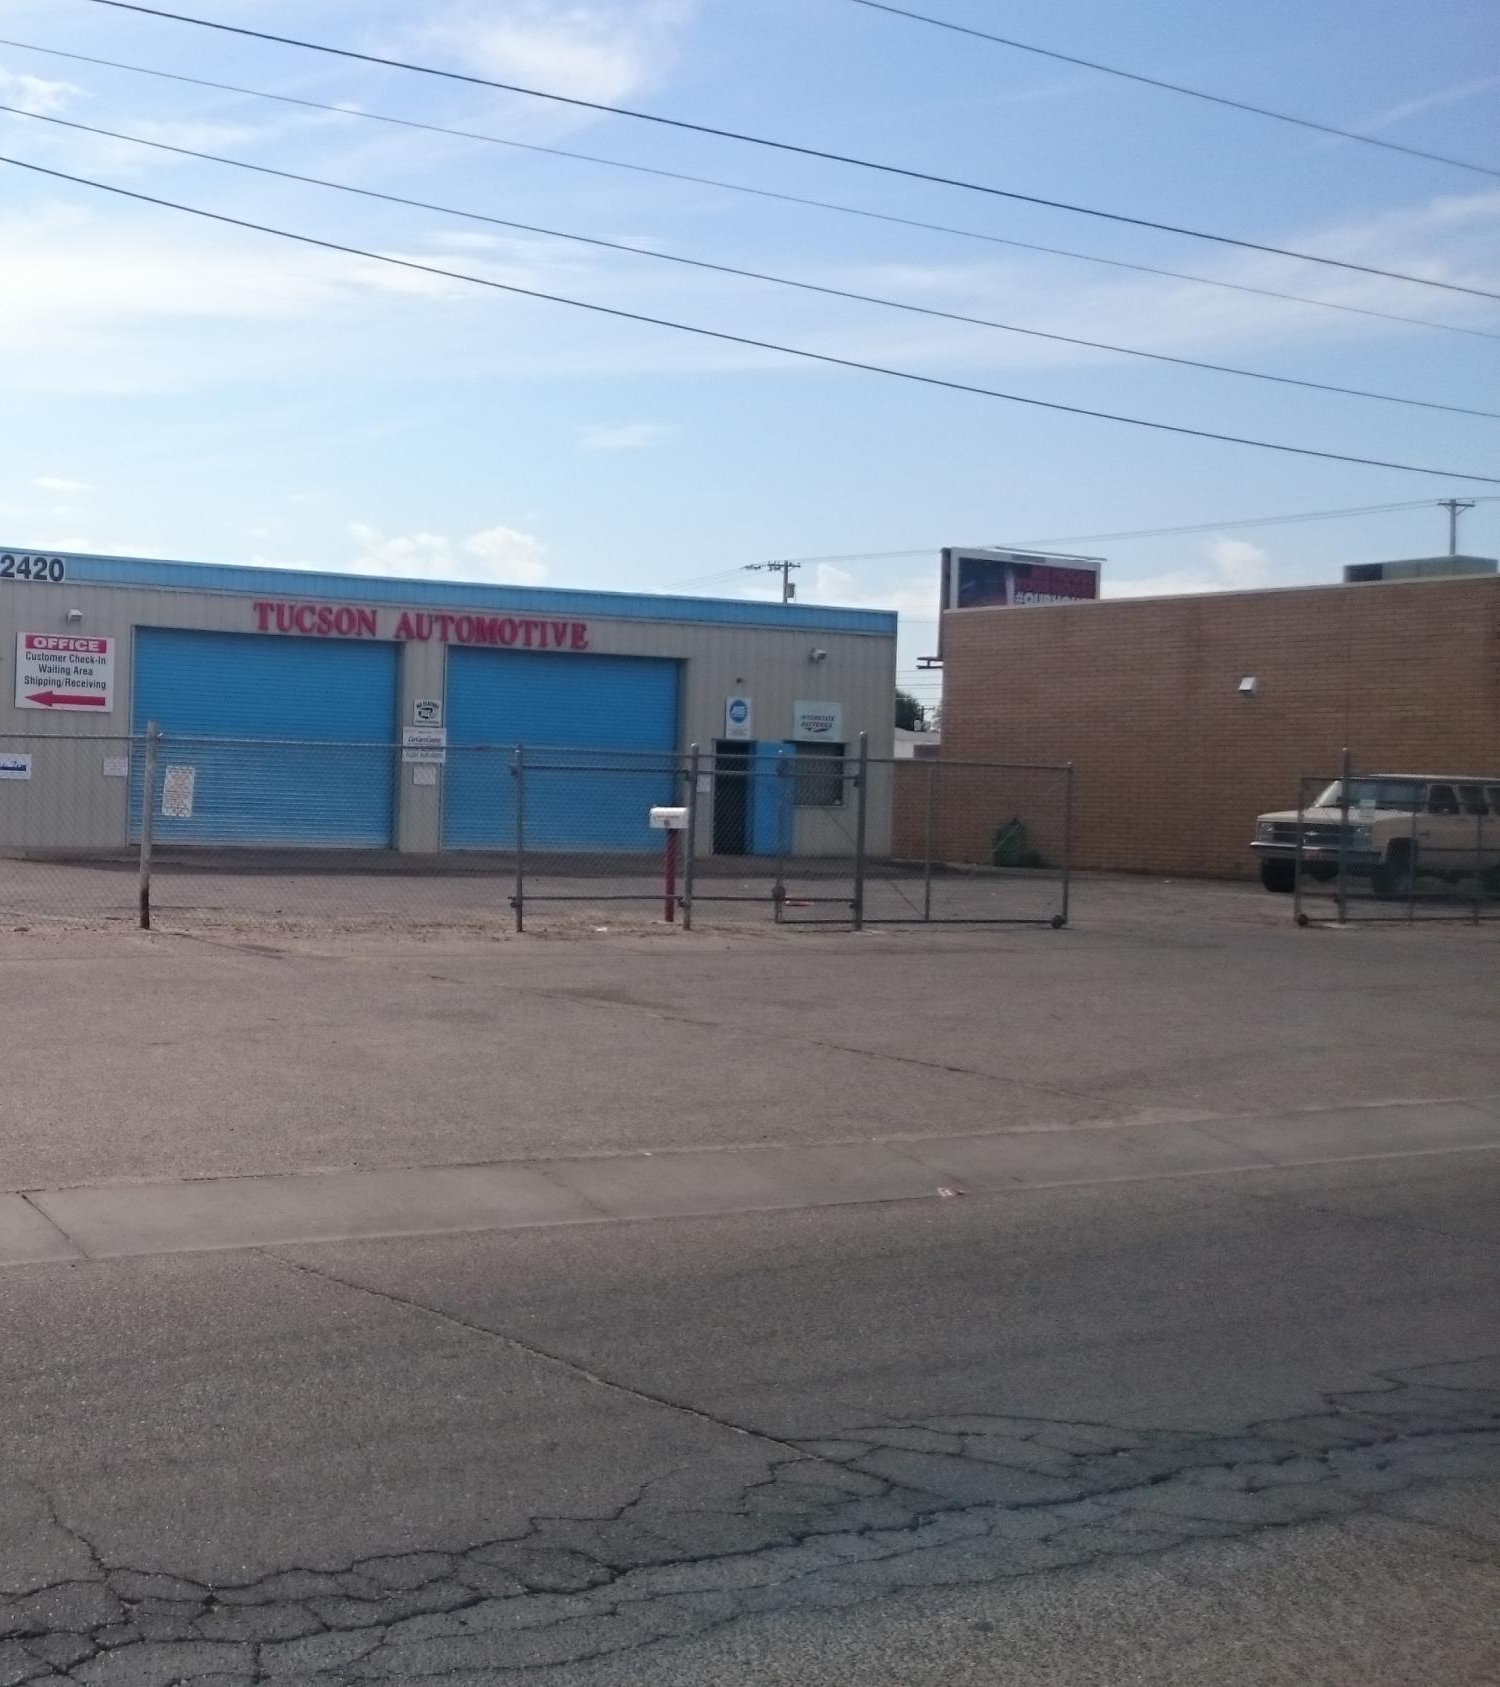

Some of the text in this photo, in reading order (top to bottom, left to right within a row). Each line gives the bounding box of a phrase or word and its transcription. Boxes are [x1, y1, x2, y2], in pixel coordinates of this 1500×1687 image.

[0, 554, 65, 582] 2420
[253, 601, 589, 650] TUCSON AUTOMOTIVE
[32, 637, 100, 652] OFFICE
[25, 651, 67, 663] Customer
[38, 663, 93, 676] Waiting Area
[24, 675, 107, 690] Shipping/Receiving
